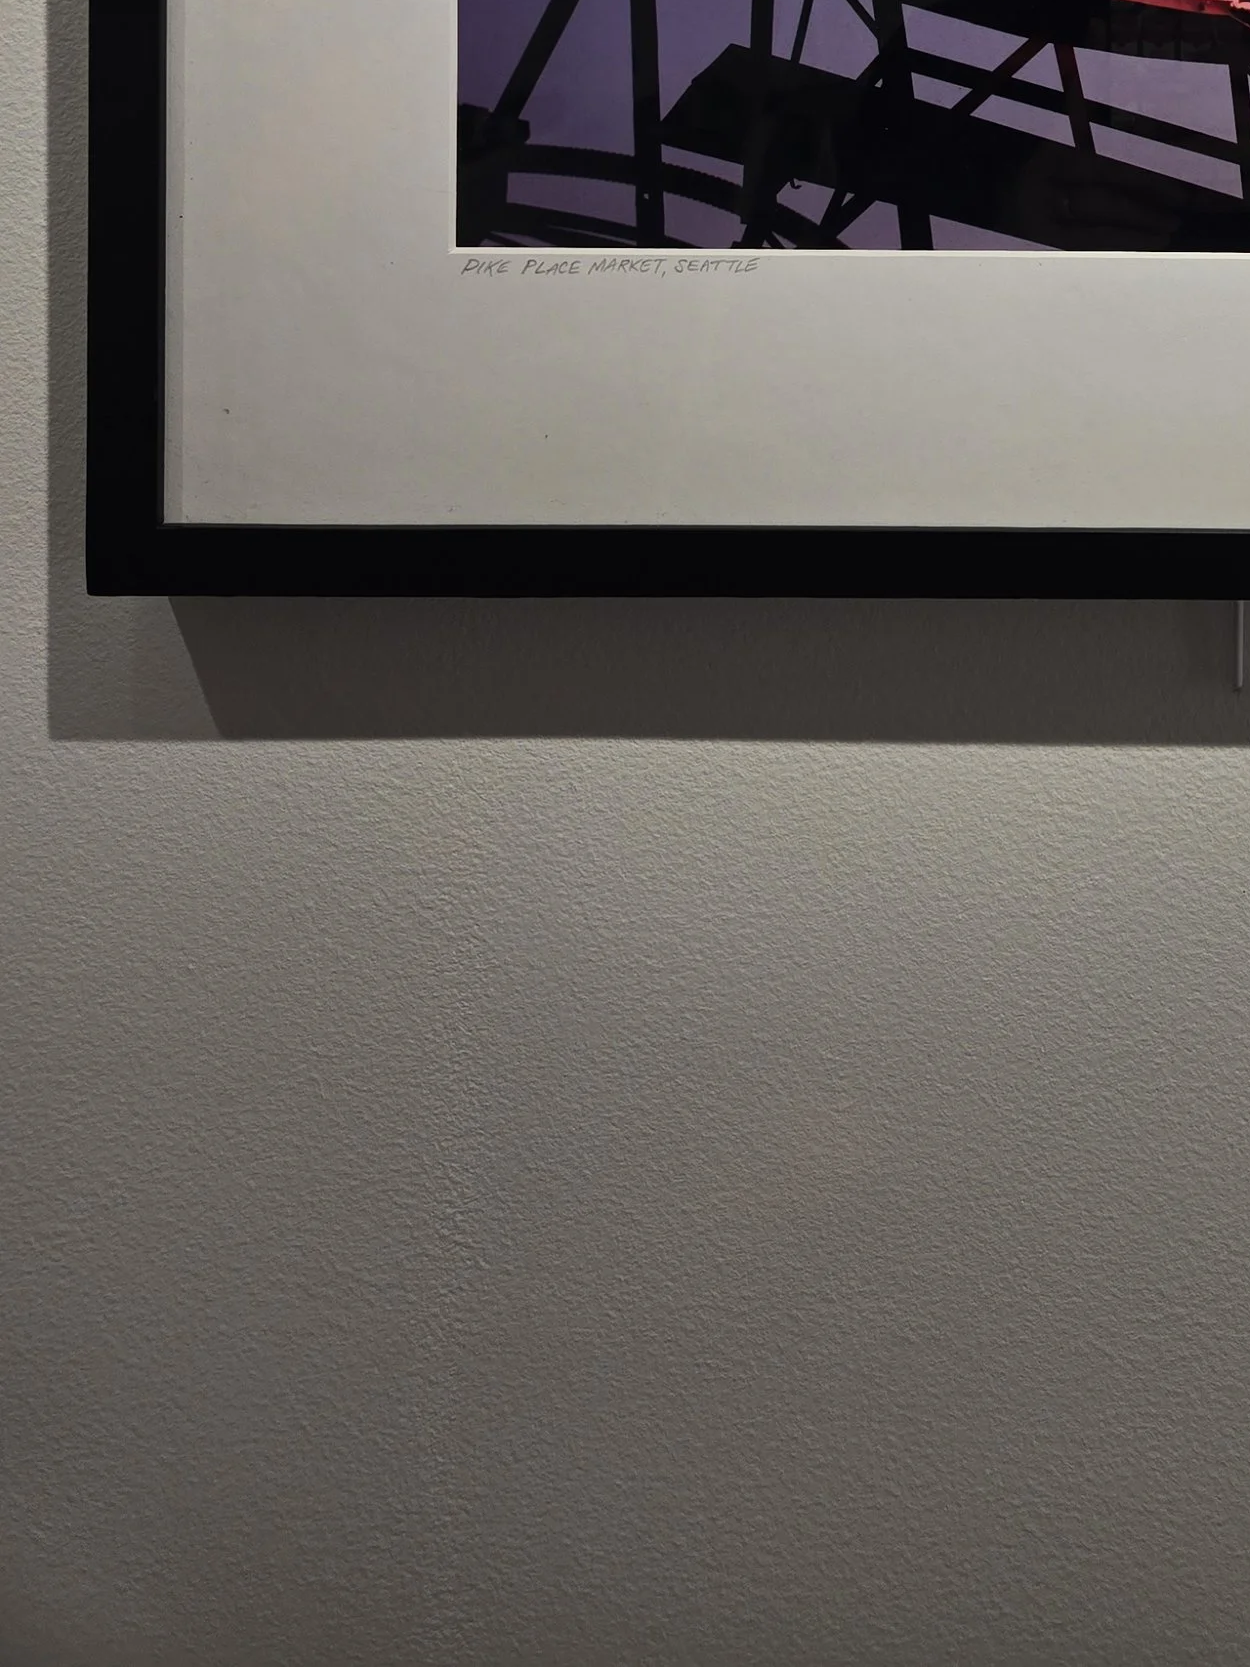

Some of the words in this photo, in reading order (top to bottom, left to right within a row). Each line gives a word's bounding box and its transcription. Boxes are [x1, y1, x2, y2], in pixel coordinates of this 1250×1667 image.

[520, 258, 582, 276] PLACE
[587, 258, 668, 278] MARKET,
[674, 257, 761, 274] SEATTLE
